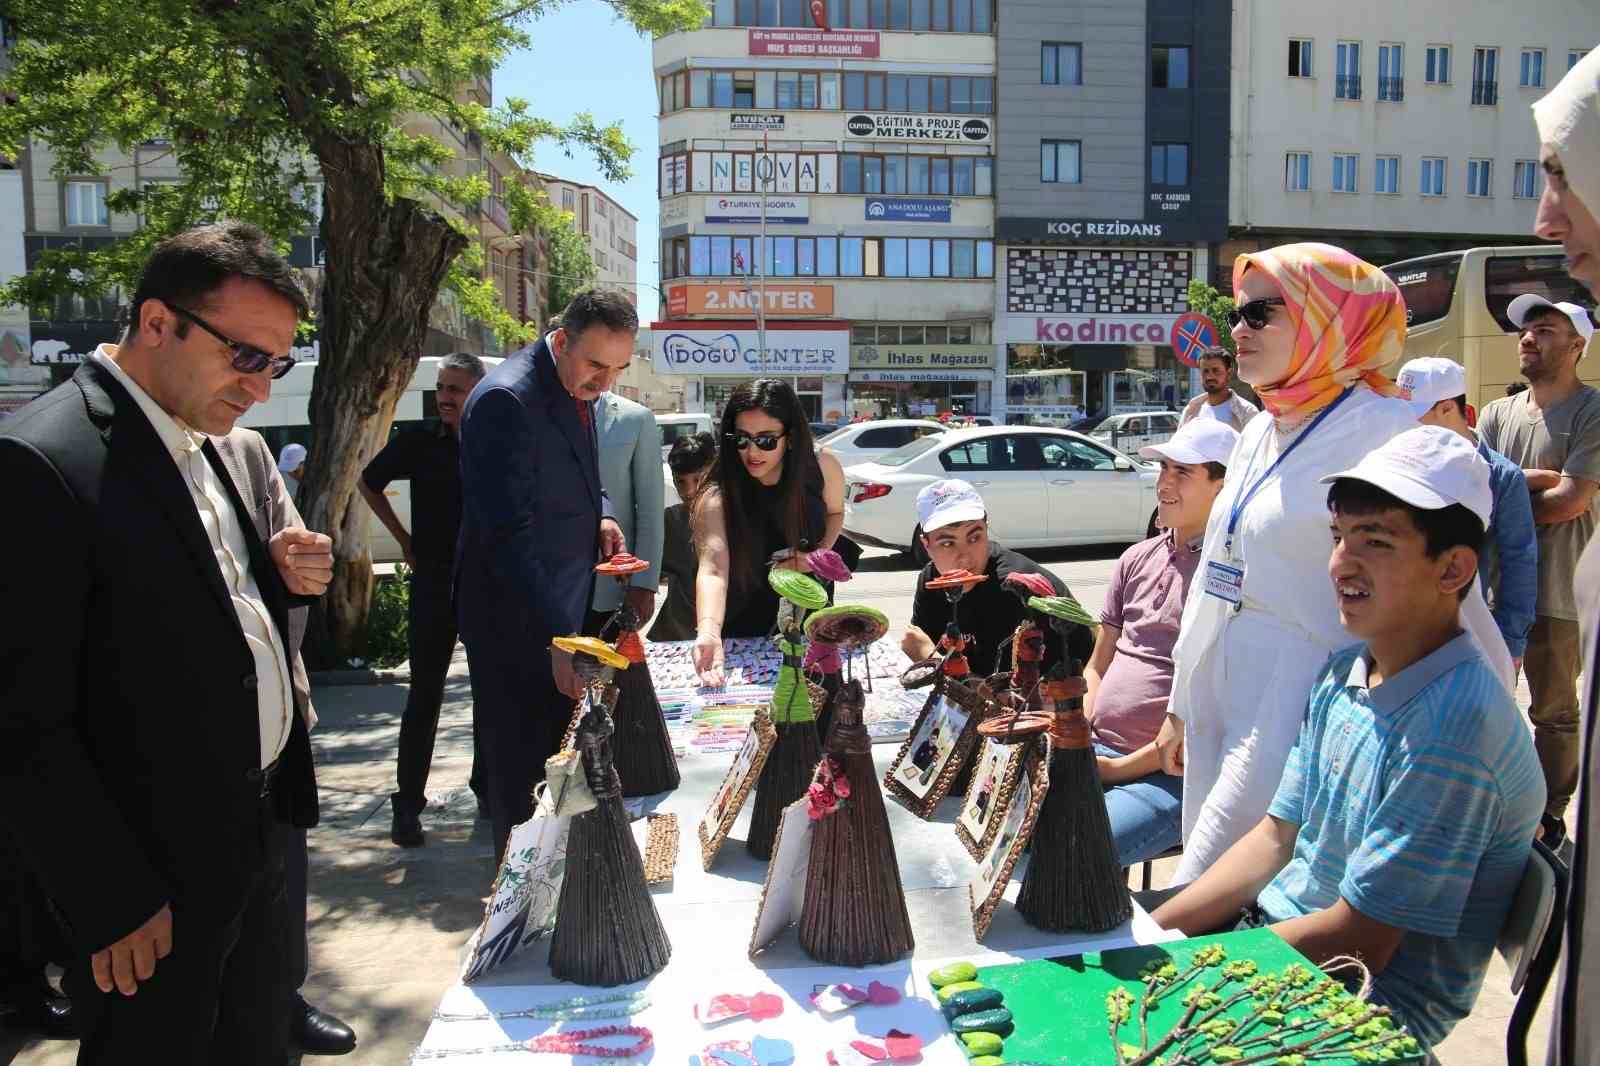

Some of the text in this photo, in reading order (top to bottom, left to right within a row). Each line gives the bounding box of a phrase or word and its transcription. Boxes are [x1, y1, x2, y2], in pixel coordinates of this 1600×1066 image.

[916, 118, 924, 128] &
[927, 119, 961, 129] PROJE
[714, 157, 814, 181] NEOVA
[1047, 219, 1162, 238] KOÇ REZİDANS
[704, 288, 816, 309] 2.NOTER
[1036, 318, 1165, 342] kadınca
[743, 348, 836, 364] CENTER
[930, 352, 988, 367] Mağazası
